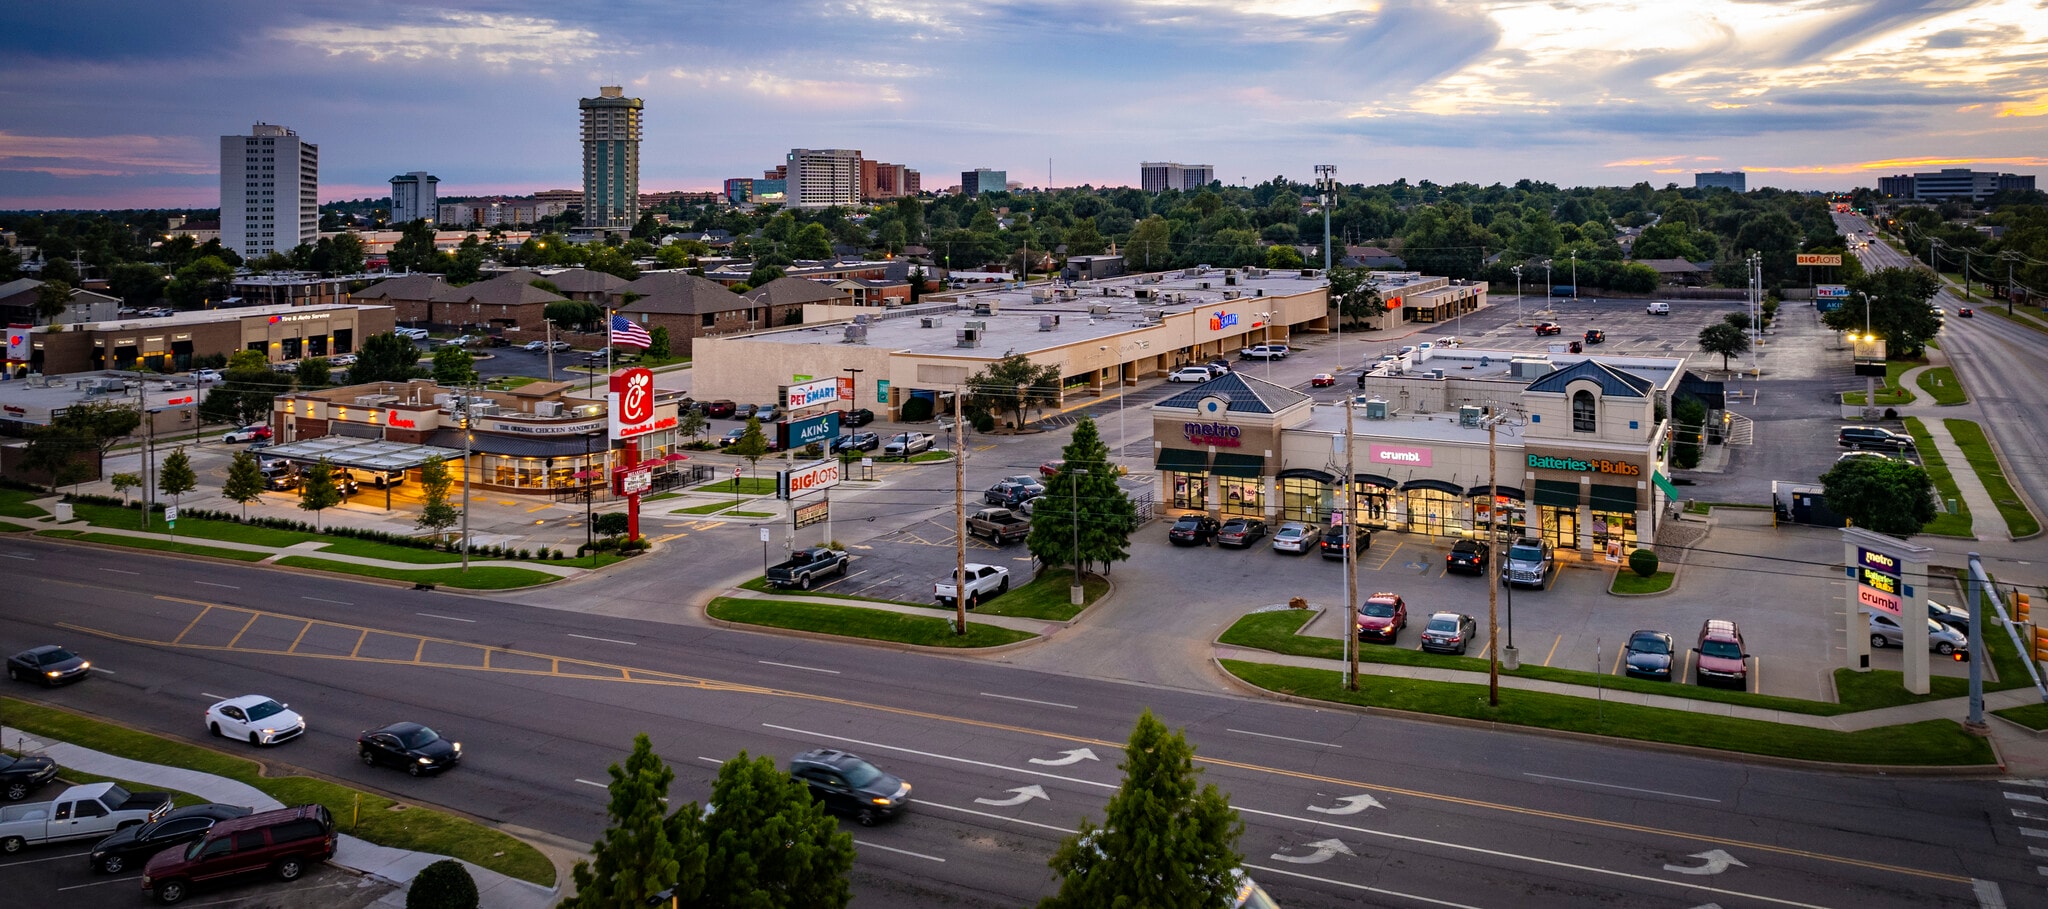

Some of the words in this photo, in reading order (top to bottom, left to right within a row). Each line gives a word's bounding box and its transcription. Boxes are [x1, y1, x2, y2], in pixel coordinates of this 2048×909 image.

[568, 423, 600, 432] SANDWICH
[1184, 421, 1240, 439] metro
[1380, 451, 1420, 461] crumbl
[1866, 552, 1893, 566] metro
[1862, 592, 1898, 611] crumbl
